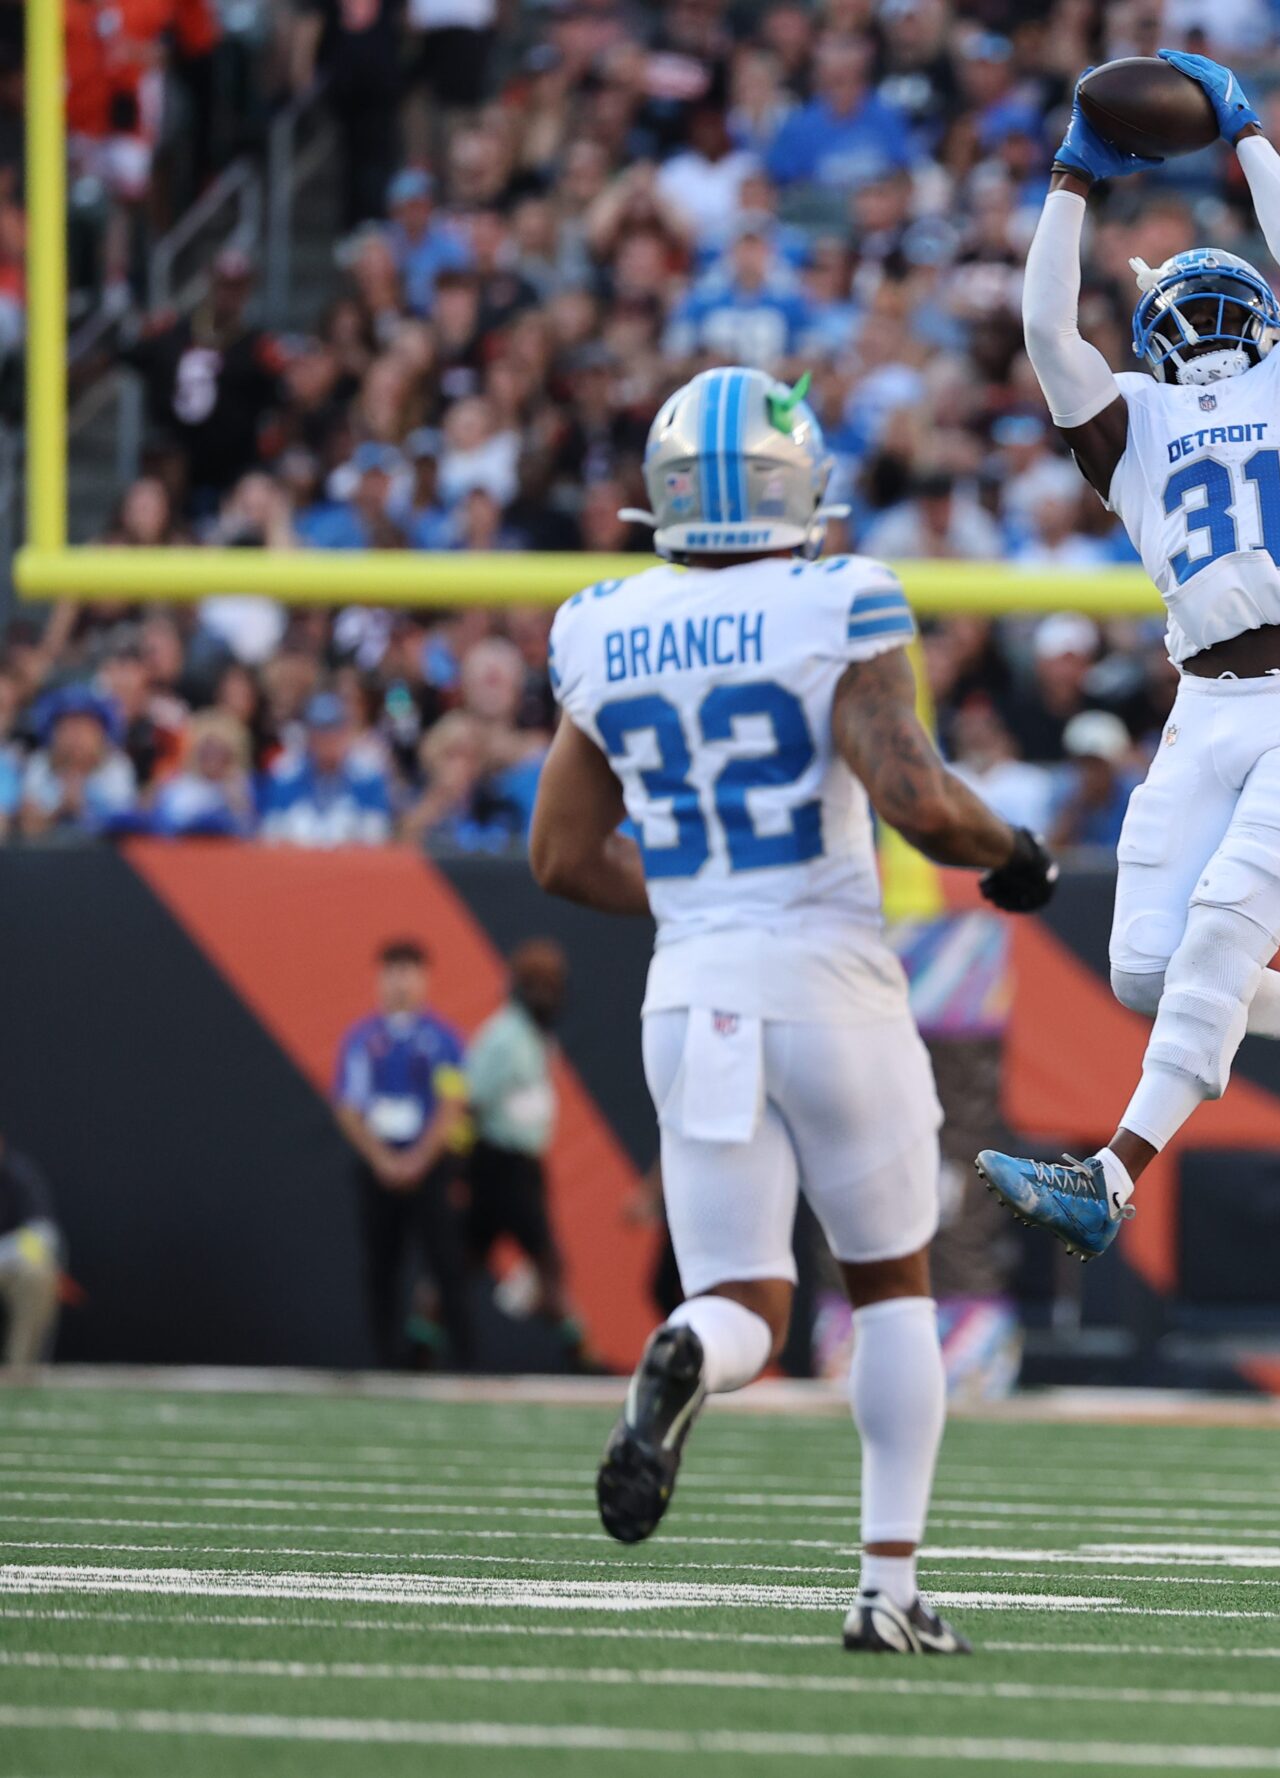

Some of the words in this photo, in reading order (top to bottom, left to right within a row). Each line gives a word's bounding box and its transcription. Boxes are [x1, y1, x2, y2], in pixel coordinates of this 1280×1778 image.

[1166, 422, 1269, 464] DETROIT
[605, 611, 764, 683] BRANCH
[594, 680, 826, 879] 32
